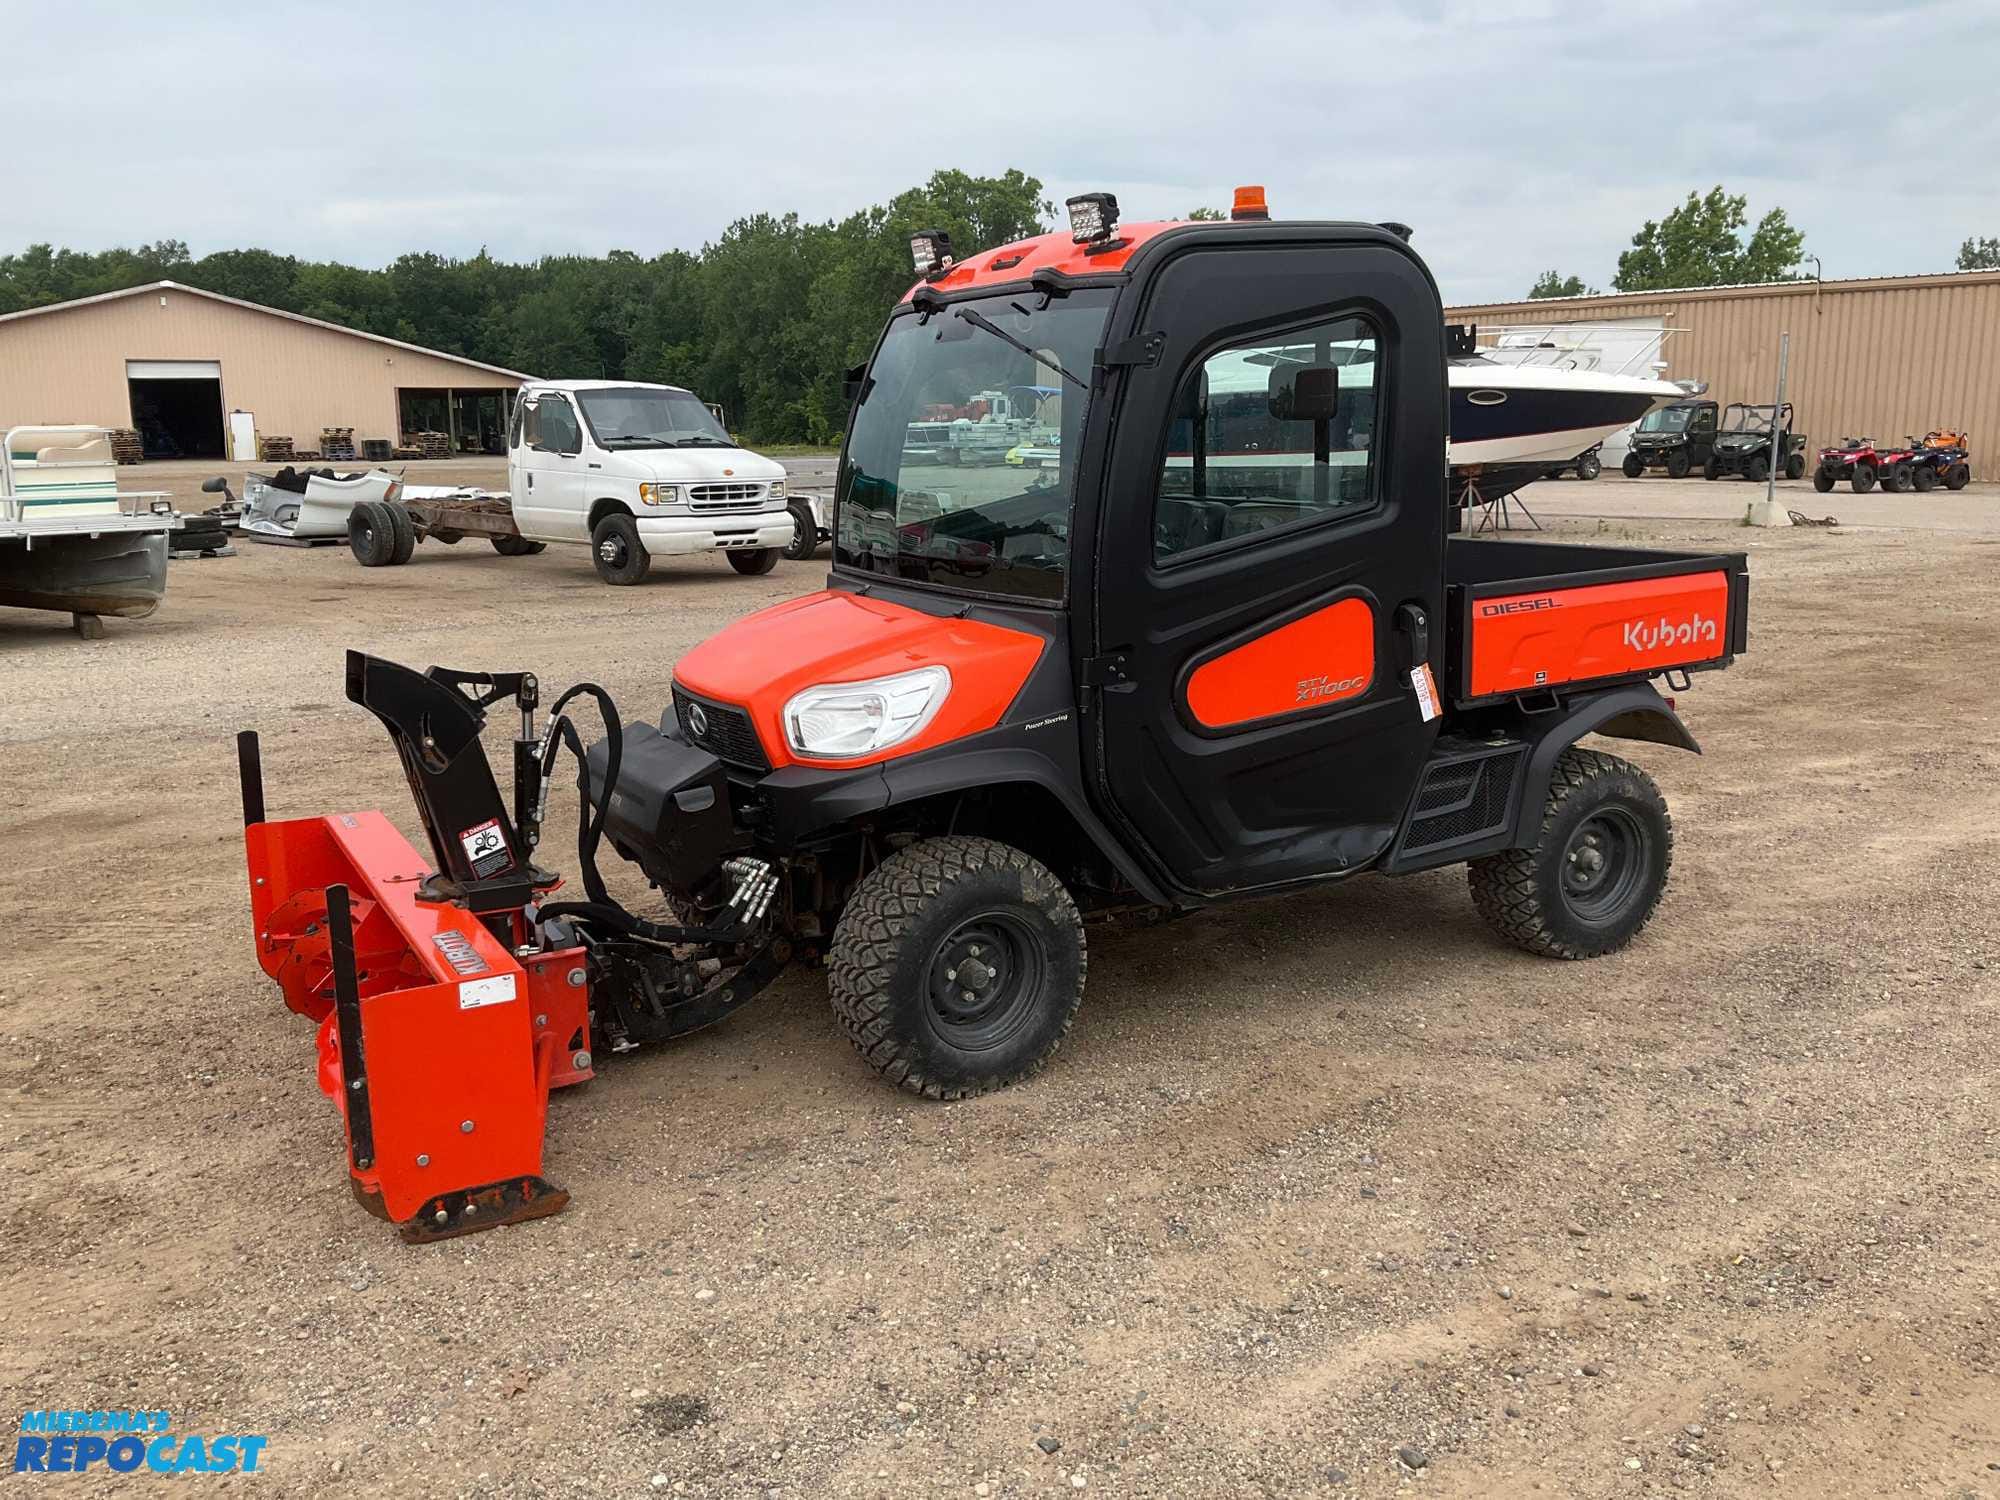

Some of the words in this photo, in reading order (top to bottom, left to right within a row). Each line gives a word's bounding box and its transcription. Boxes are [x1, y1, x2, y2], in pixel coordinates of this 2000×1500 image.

[1482, 598, 1564, 617] DIESEL
[1623, 613, 1716, 651] Kubota
[1297, 675, 1329, 689] RTV
[1025, 722, 1044, 731] Power
[1044, 714, 1068, 725] Steering
[468, 821, 493, 835] DANGER
[432, 930, 490, 975] KUBOTA
